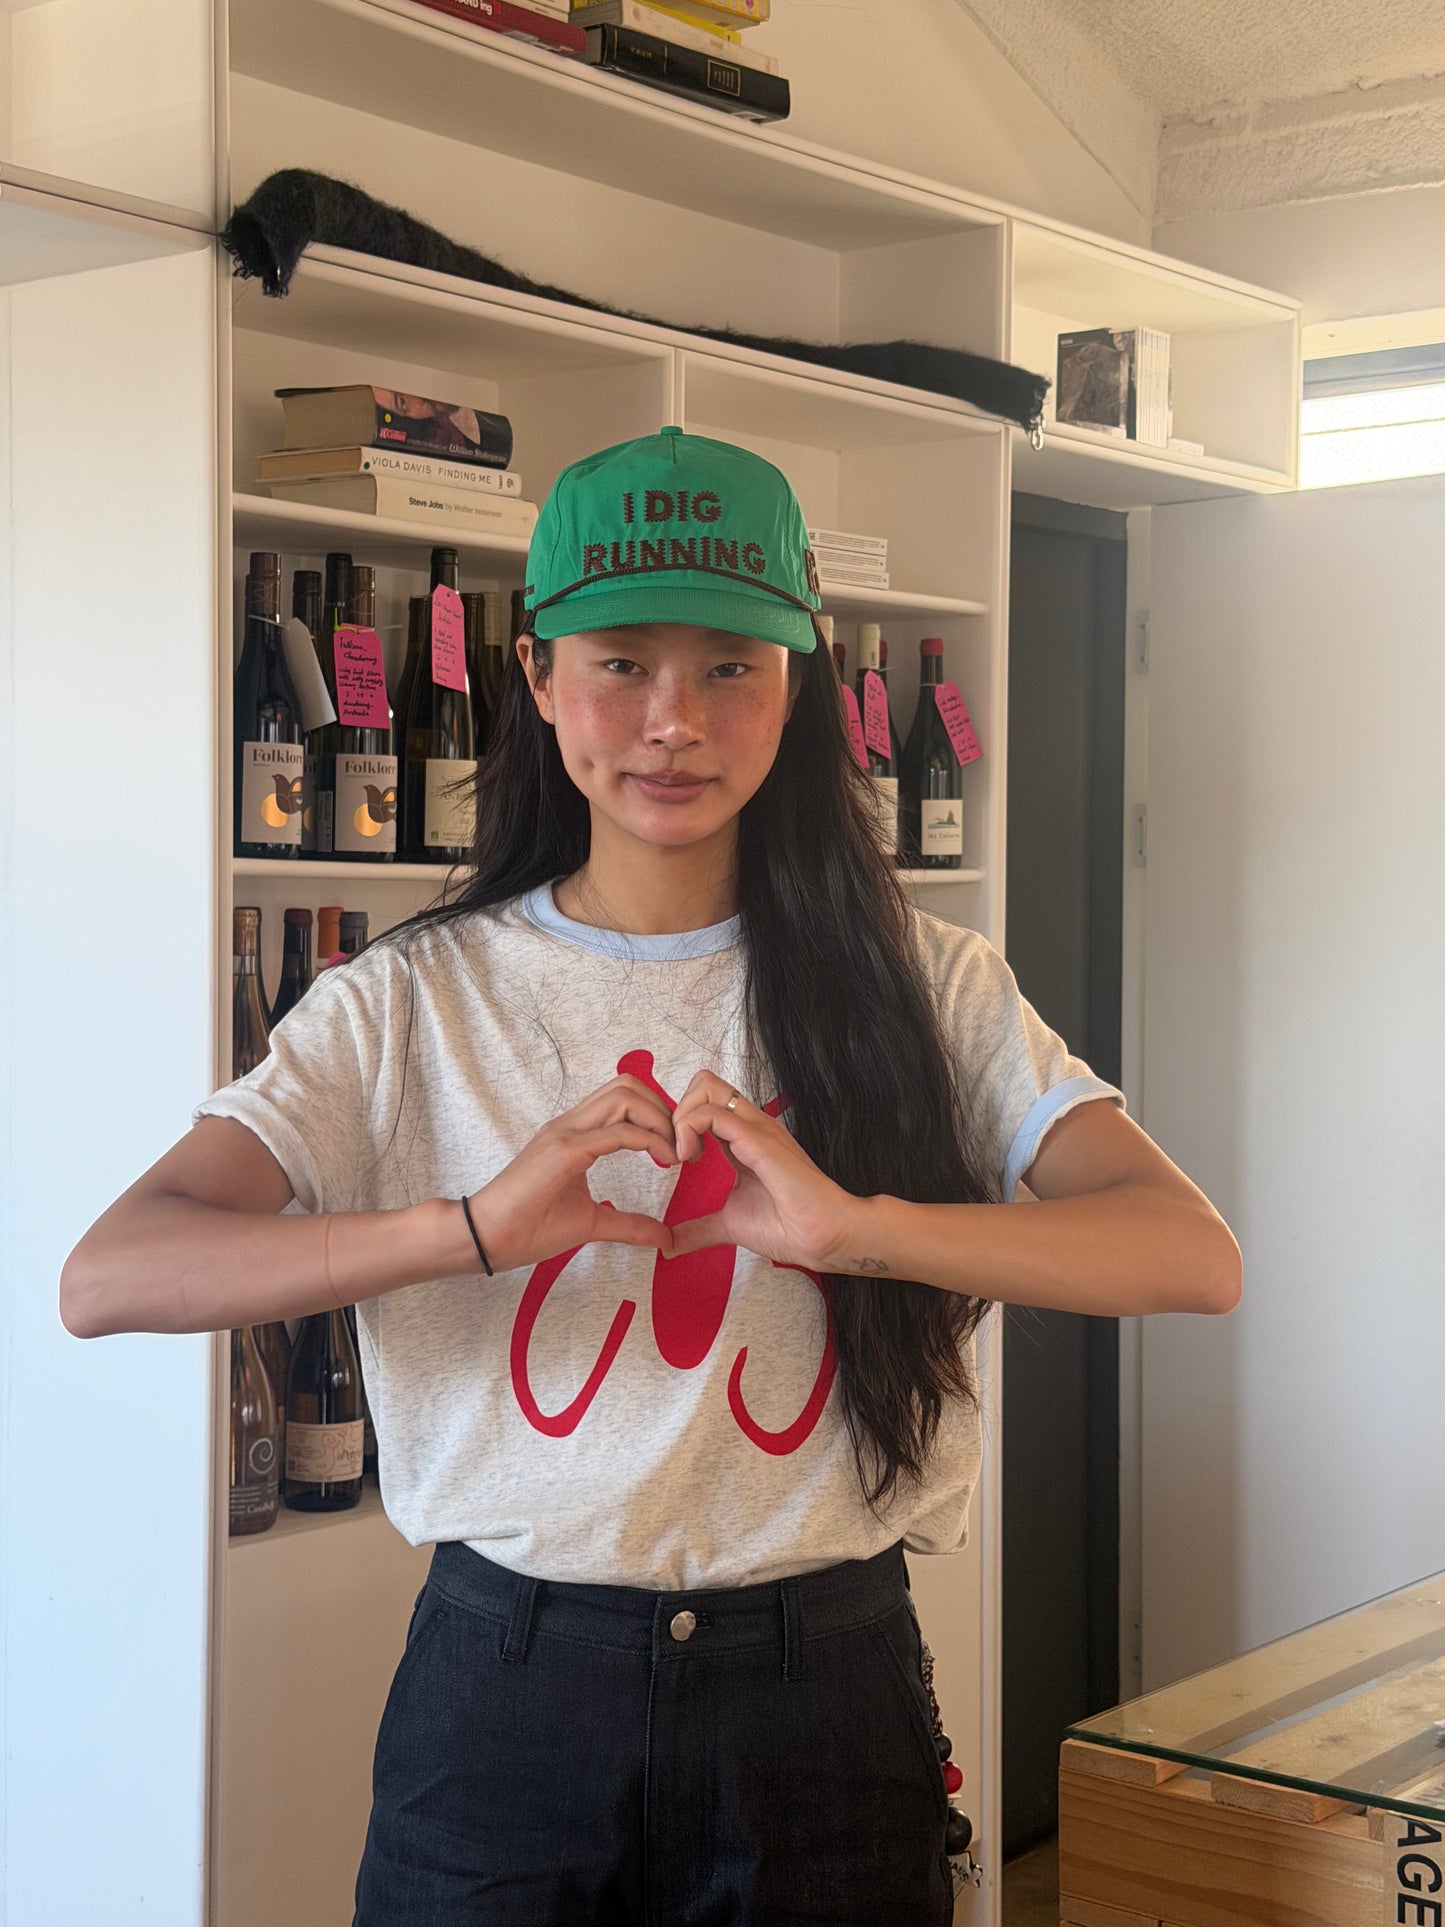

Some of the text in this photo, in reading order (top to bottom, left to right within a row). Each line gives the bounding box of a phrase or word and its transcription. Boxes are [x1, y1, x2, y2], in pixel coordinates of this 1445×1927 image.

[372, 457, 401, 470] VIOLA
[403, 462, 432, 475] DAVIS
[438, 467, 477, 482] FINDING
[479, 474, 492, 485] ME
[408, 497, 427, 508] Steve
[428, 499, 444, 510] Jobs
[445, 502, 453, 512] by
[623, 490, 722, 524] I DIG
[583, 536, 767, 576] RUNNING
[1397, 1817, 1443, 1927] AGE
